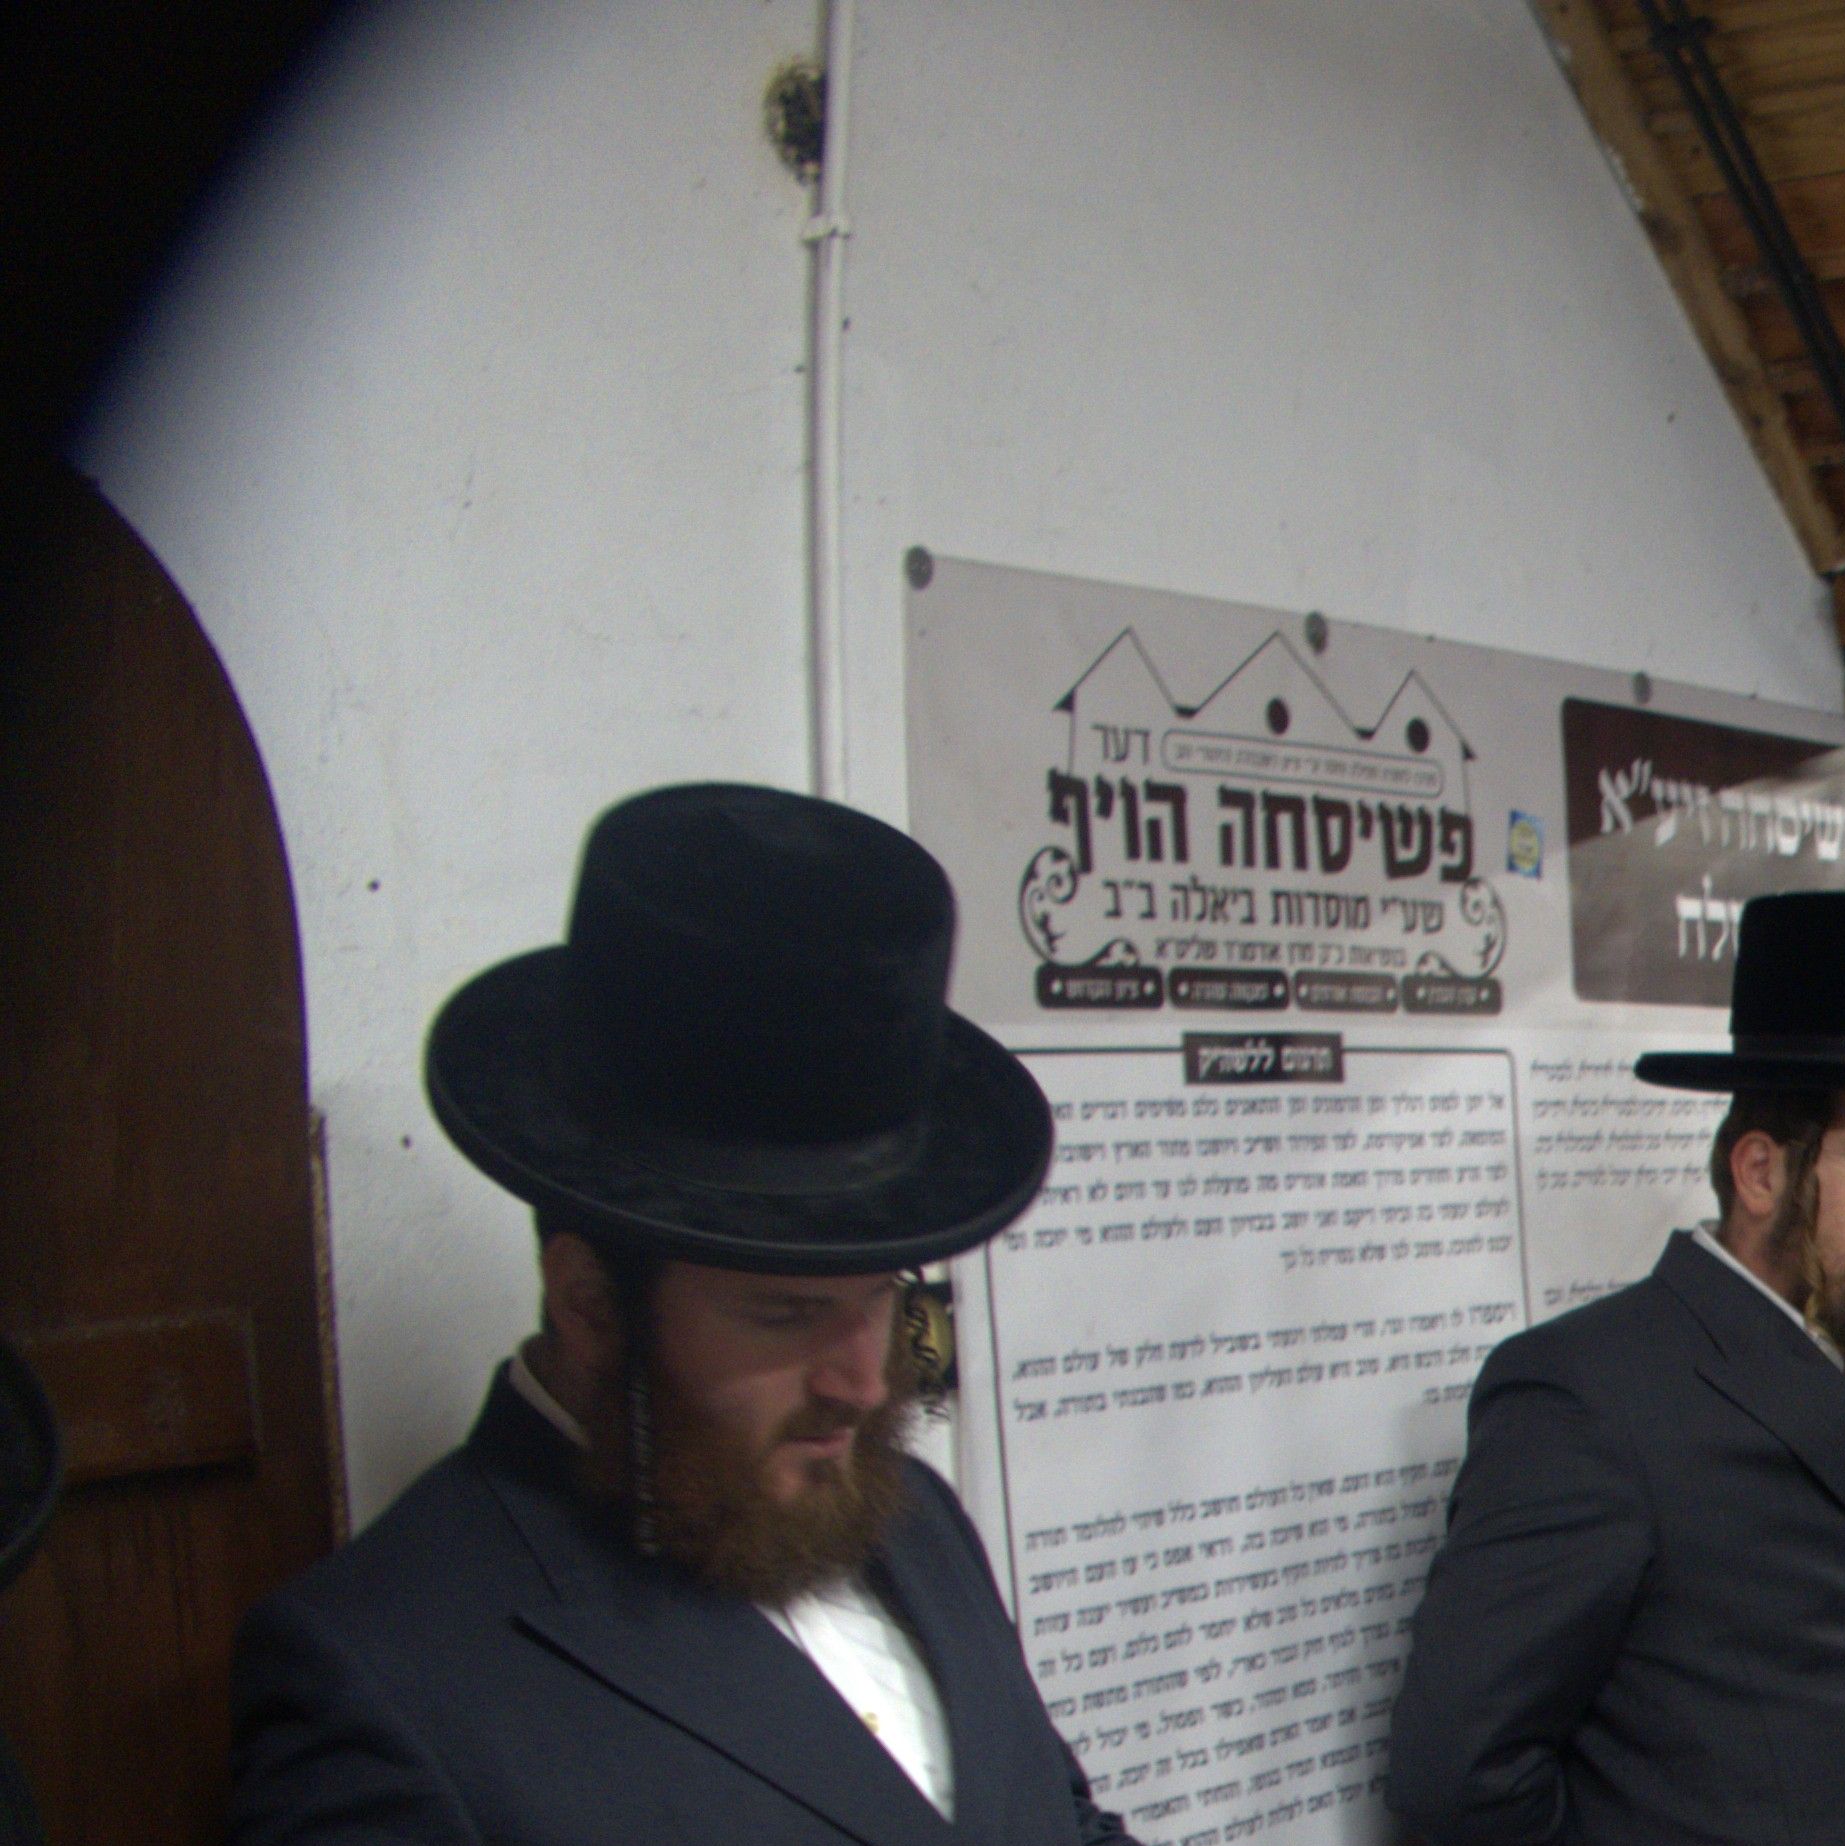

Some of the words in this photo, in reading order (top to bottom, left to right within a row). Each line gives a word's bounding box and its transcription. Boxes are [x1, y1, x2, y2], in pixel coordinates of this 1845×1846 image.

[1091, 723, 1150, 765] דער
[1047, 768, 1190, 874] הויף
[1218, 784, 1474, 883] פשיסחה
[1170, 876, 1258, 926] ביאלה
[1270, 888, 1370, 929] מוסדות
